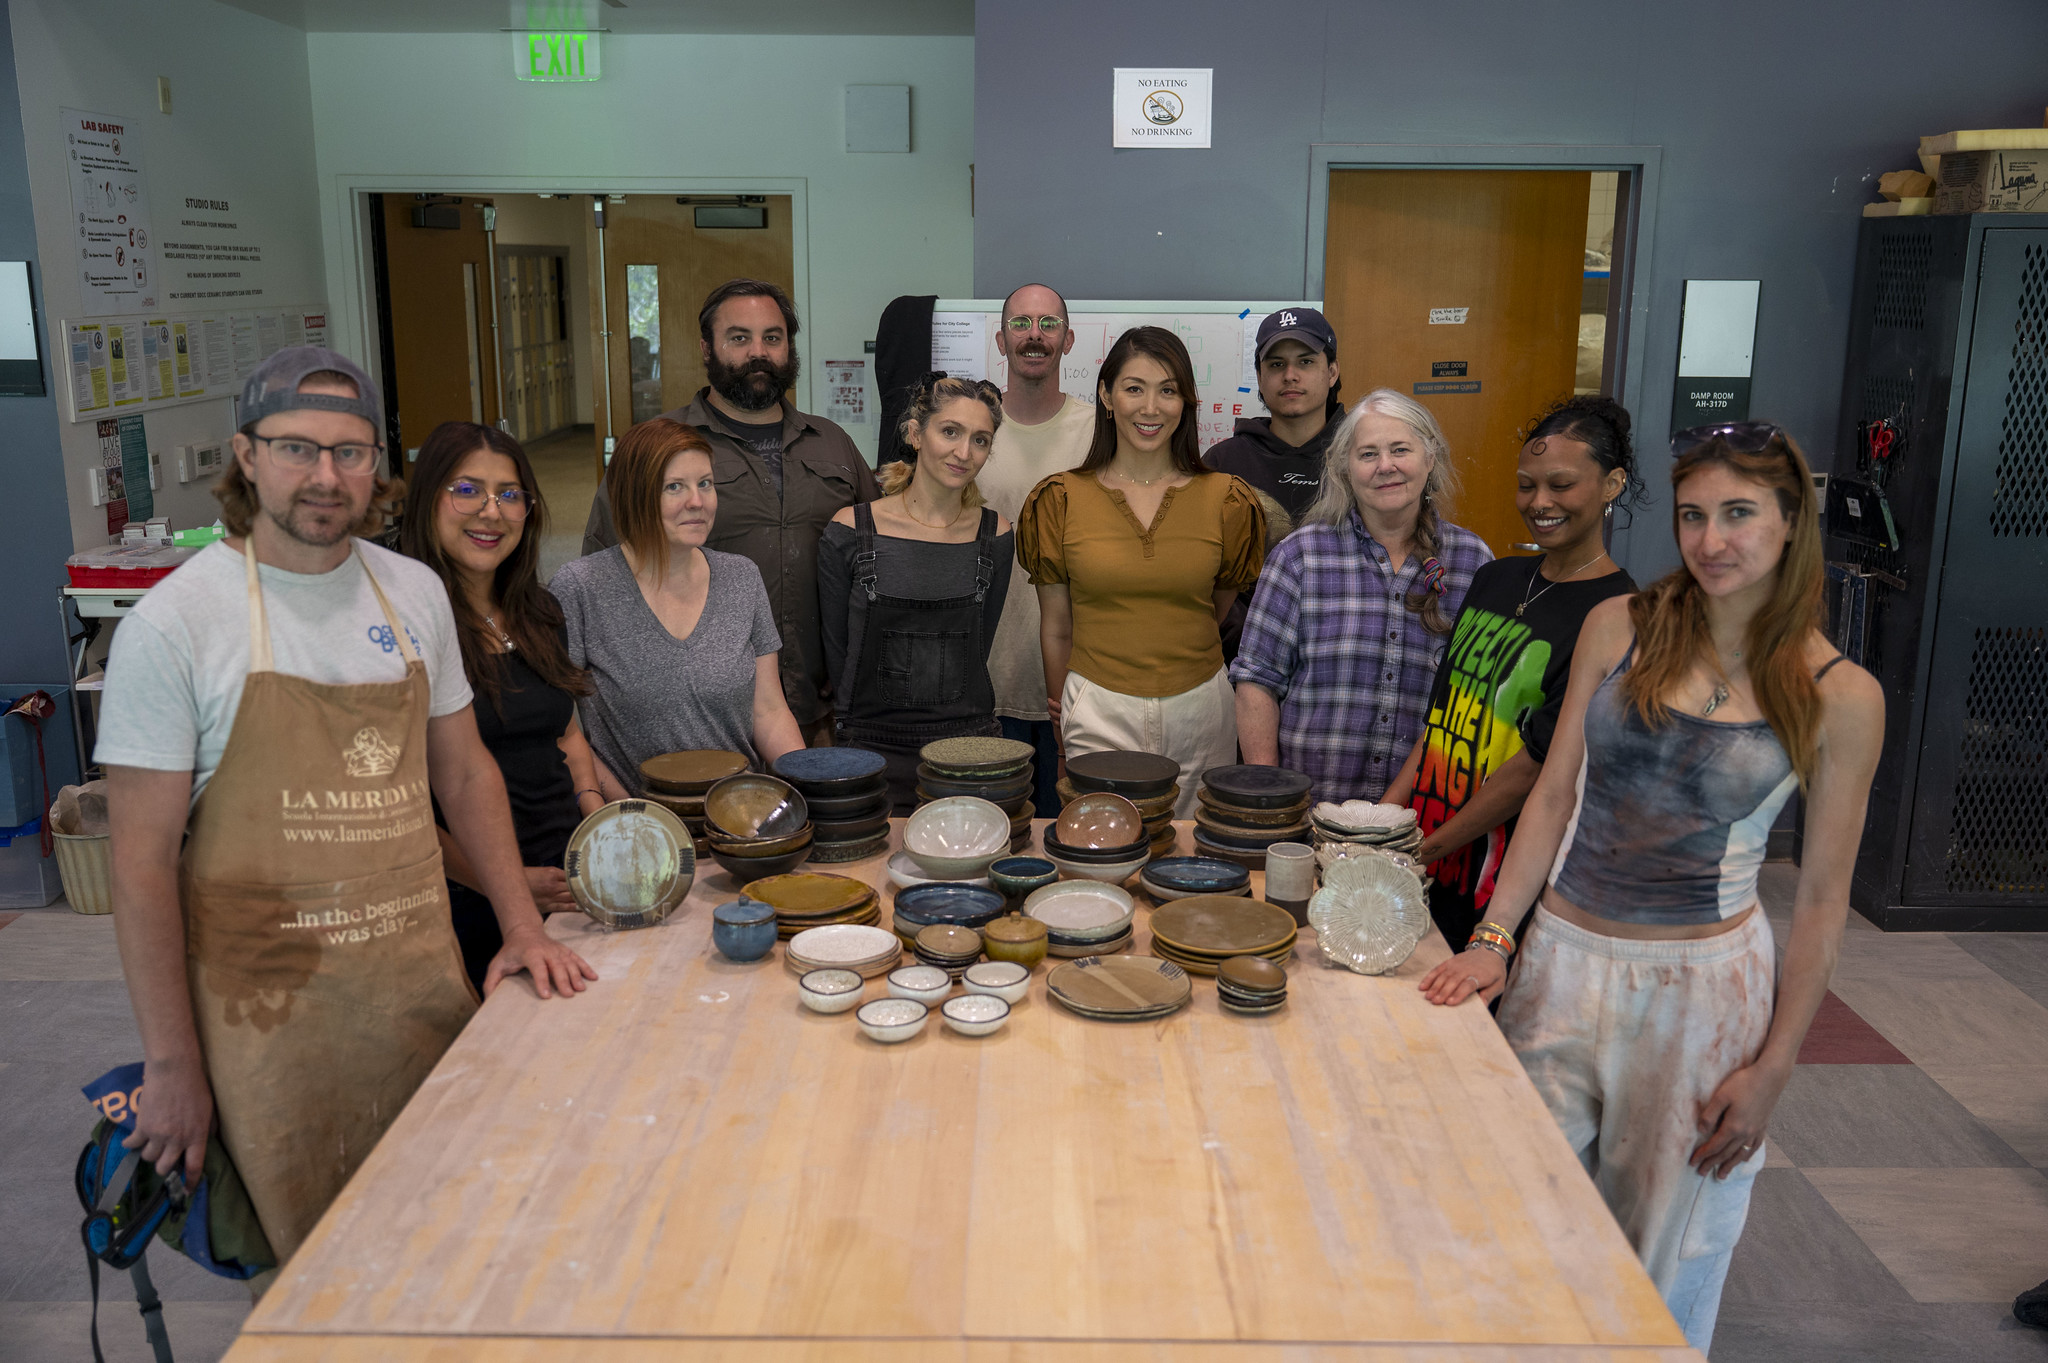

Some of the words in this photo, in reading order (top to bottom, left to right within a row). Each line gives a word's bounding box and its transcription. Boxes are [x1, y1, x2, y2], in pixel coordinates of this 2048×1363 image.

[528, 34, 588, 76] EXIT
[1153, 79, 1188, 87] EATING
[81, 120, 96, 131] LAB
[98, 122, 124, 135] SAFETY
[1131, 128, 1145, 136] NO
[1147, 128, 1192, 136] DRINKING
[185, 198, 208, 209] STUDIO
[210, 200, 229, 211] RULES
[1279, 311, 1297, 327] LA
[1690, 392, 1711, 400] DAMP
[1713, 392, 1734, 400] ROOM
[1695, 400, 1727, 408] AH-317D
[103, 436, 119, 449] LIVE
[103, 455, 122, 468] CODE
[282, 789, 319, 809] LA
[365, 886, 440, 920] beginning
[327, 926, 370, 945] was
